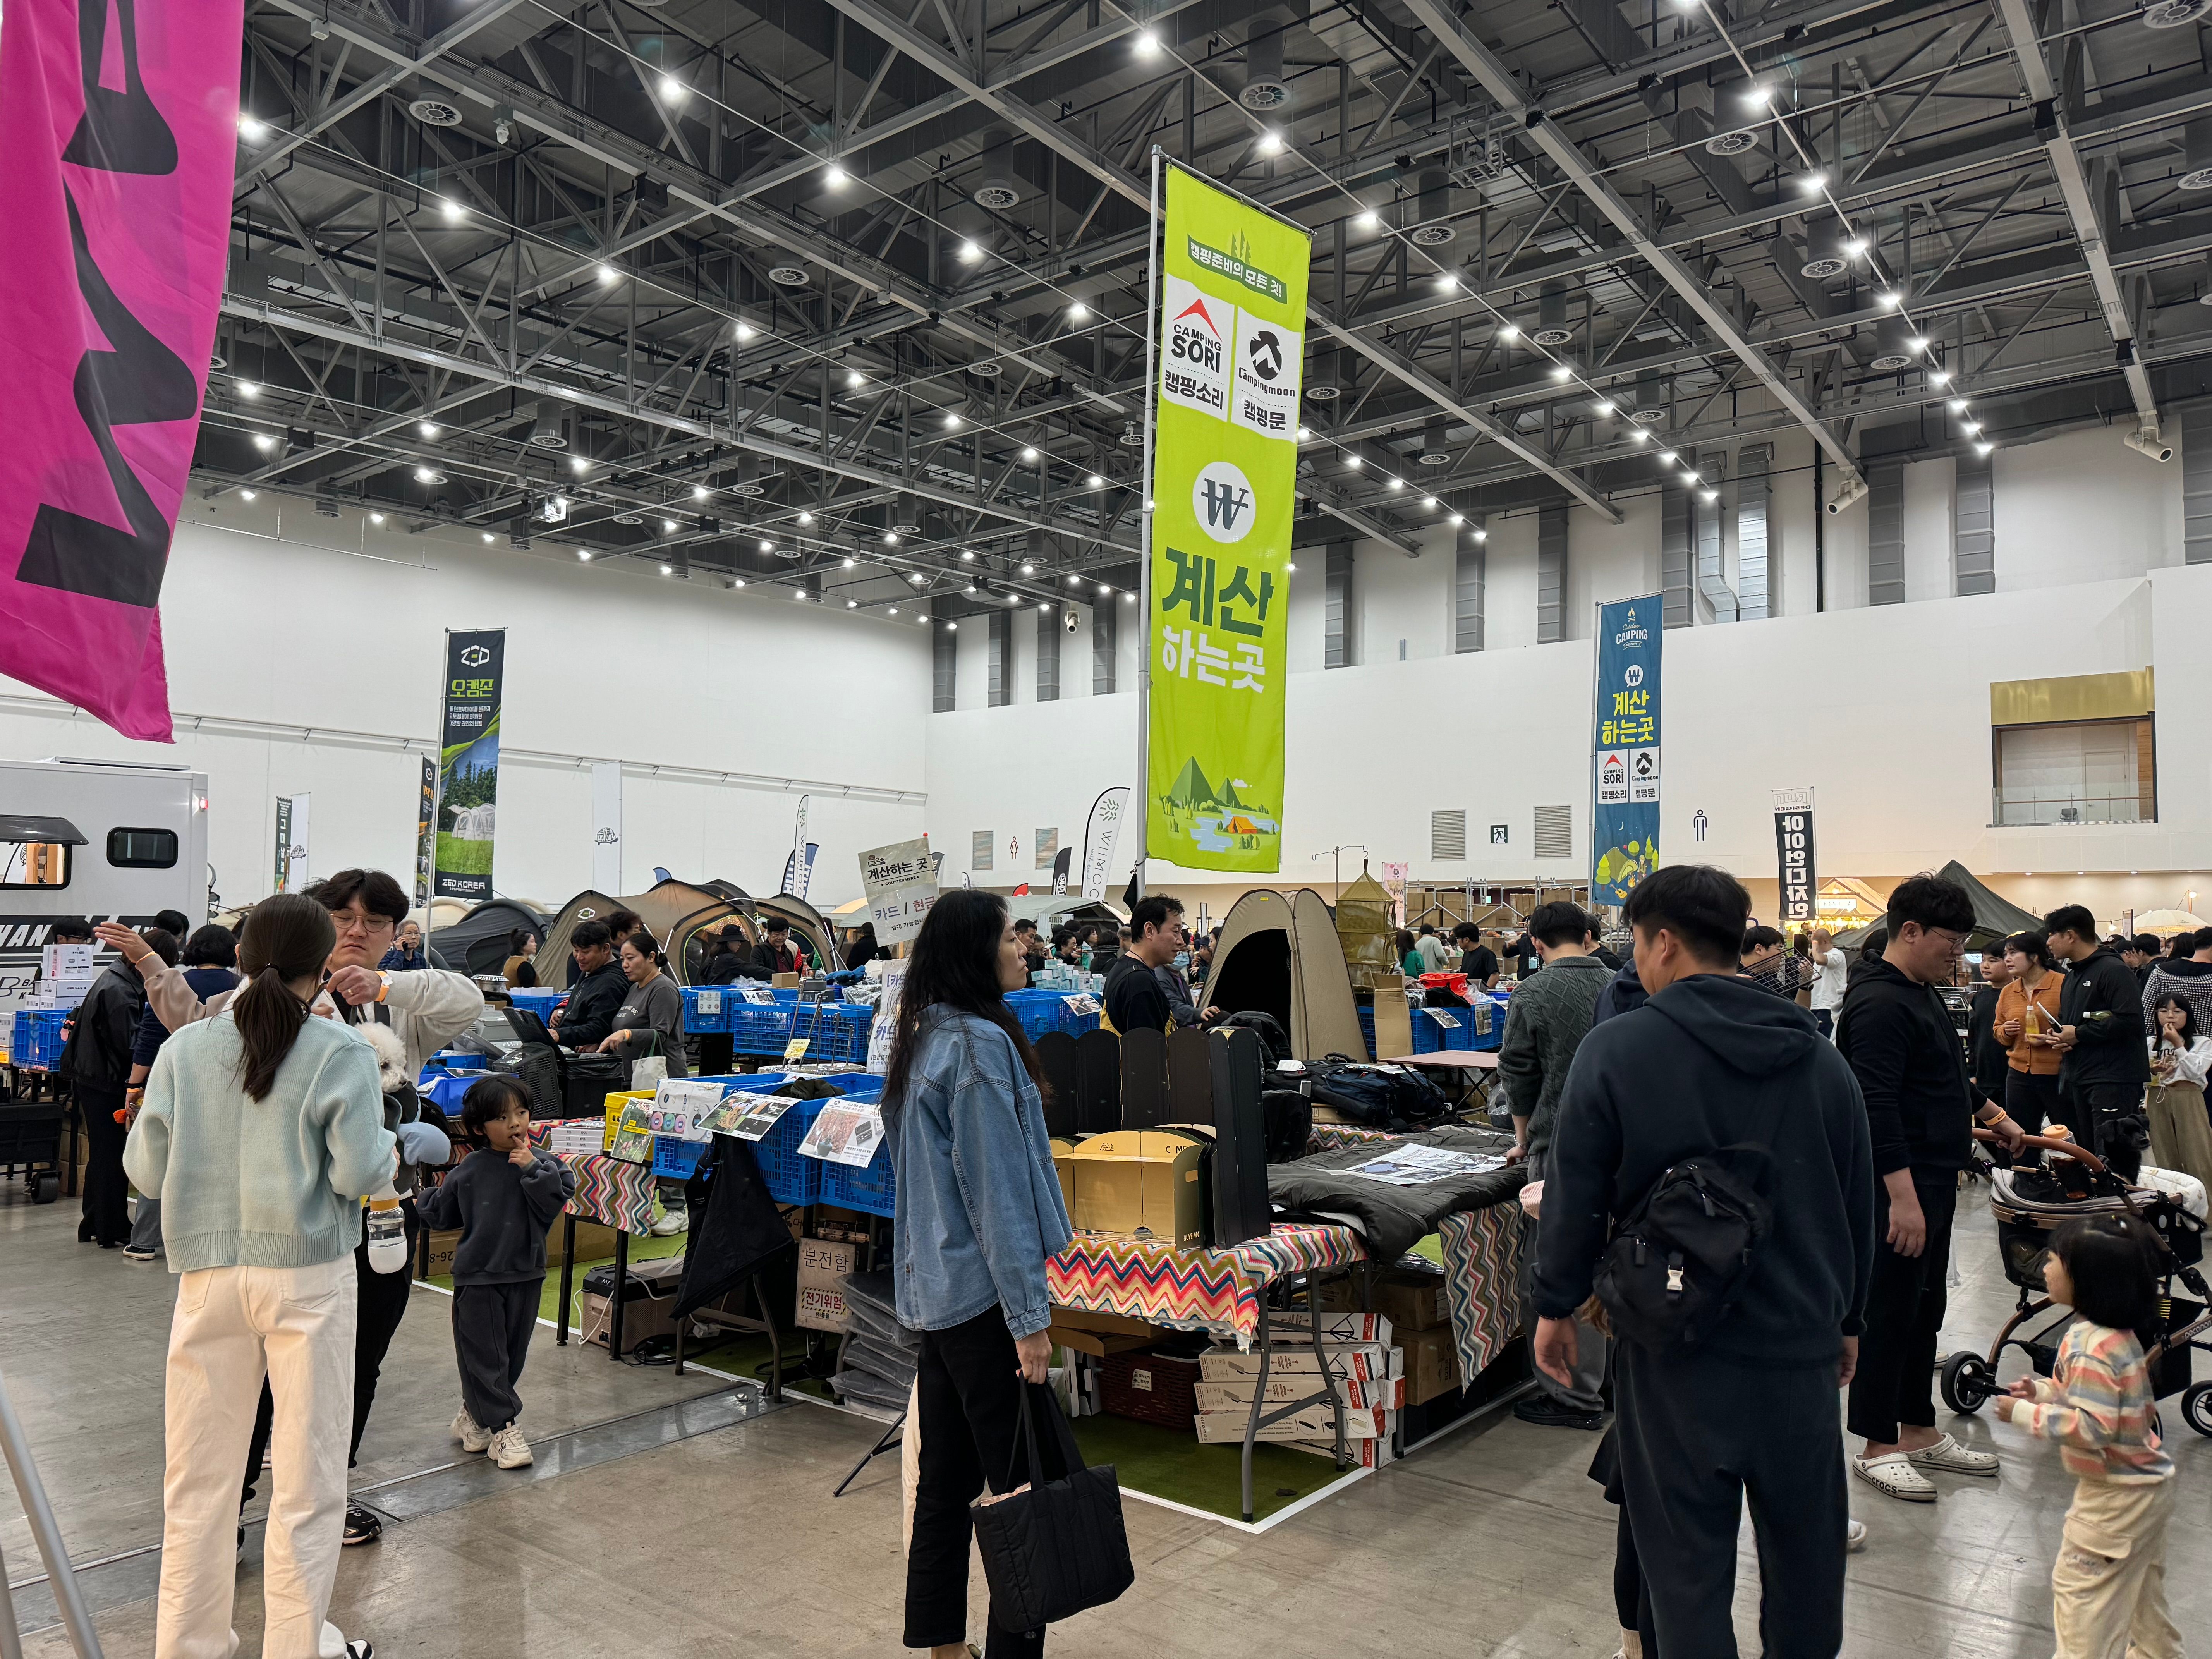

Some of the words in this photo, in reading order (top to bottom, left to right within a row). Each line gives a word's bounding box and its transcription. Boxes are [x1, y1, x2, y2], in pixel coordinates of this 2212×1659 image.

[1190, 241, 1243, 280] 캠핑준비의
[1245, 269, 1267, 290] 모든
[1270, 281, 1282, 298] 것!
[1174, 325, 1221, 352] CAMPING
[1171, 335, 1221, 373] SORI
[1165, 369, 1223, 410] 캠핑소리
[1239, 367, 1295, 397] Campingmoon
[1244, 400, 1286, 430] 캠핑문
[1163, 546, 1274, 637] 계산
[1616, 629, 1648, 645] CAMPING
[1163, 625, 1265, 693] 하는곳
[450, 679, 494, 697] 오캠존
[1612, 689, 1650, 716] 계산
[1601, 716, 1654, 744] 하는곳
[1603, 773, 1624, 785] SORI
[1601, 789, 1626, 800] 캠핑소리
[1635, 788, 1656, 799] 캠핑문
[867, 862, 913, 880] 계산하는
[917, 857, 927, 870] 곳
[442, 879, 457, 887] ZED
[458, 880, 485, 890] KOREA
[875, 905, 900, 920] 카드
[804, 1249, 849, 1273] 분전함
[806, 1292, 842, 1310] 전기위험
